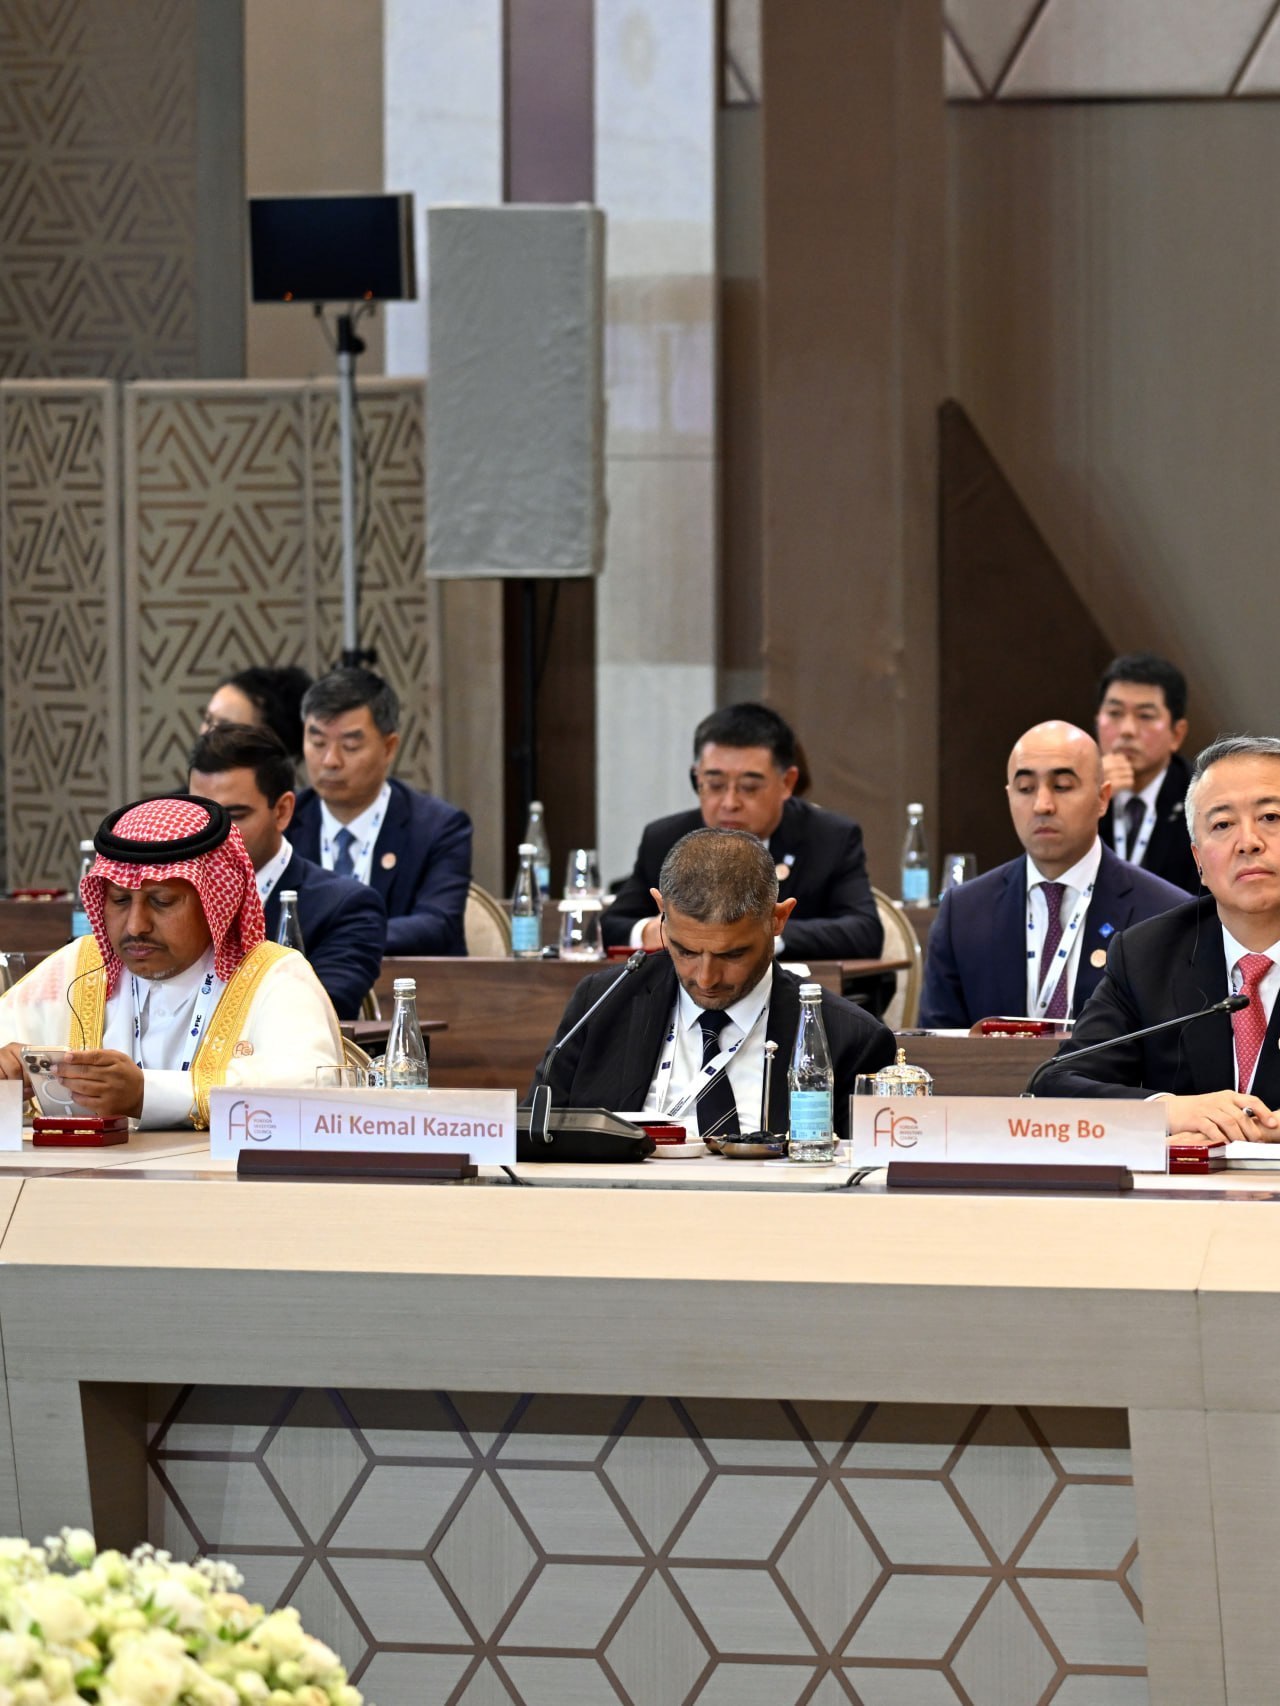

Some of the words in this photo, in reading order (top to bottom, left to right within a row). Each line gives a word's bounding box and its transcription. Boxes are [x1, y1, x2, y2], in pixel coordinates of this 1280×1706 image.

[314, 1114, 342, 1135] Ali
[350, 1116, 416, 1136] Kemal
[423, 1117, 504, 1138] Kazancı
[1008, 1118, 1070, 1143] Wang
[1077, 1120, 1105, 1139] Bo
